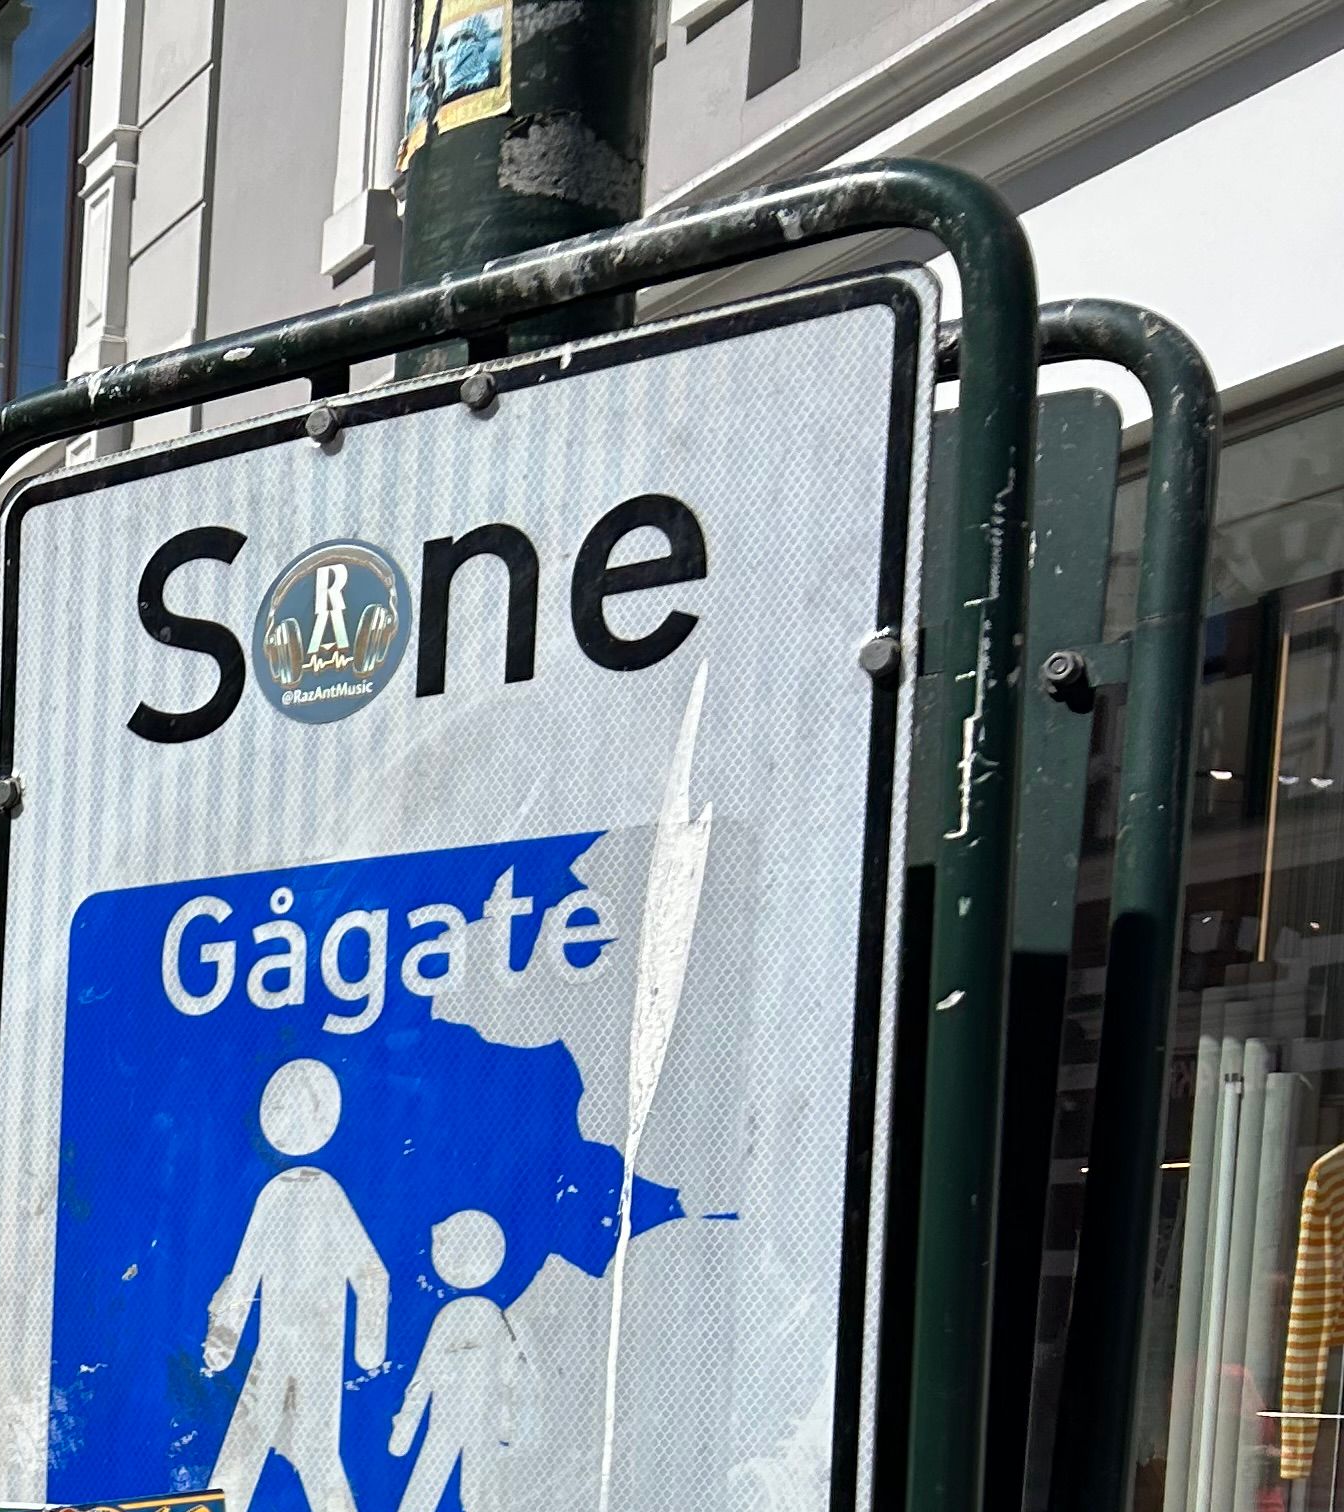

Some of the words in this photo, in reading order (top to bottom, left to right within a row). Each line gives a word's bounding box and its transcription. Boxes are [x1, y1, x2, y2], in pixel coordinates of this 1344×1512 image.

[126, 492, 708, 745] Sne
[281, 679, 374, 706] @RazAntMusic
[161, 866, 614, 1036] Gågate
